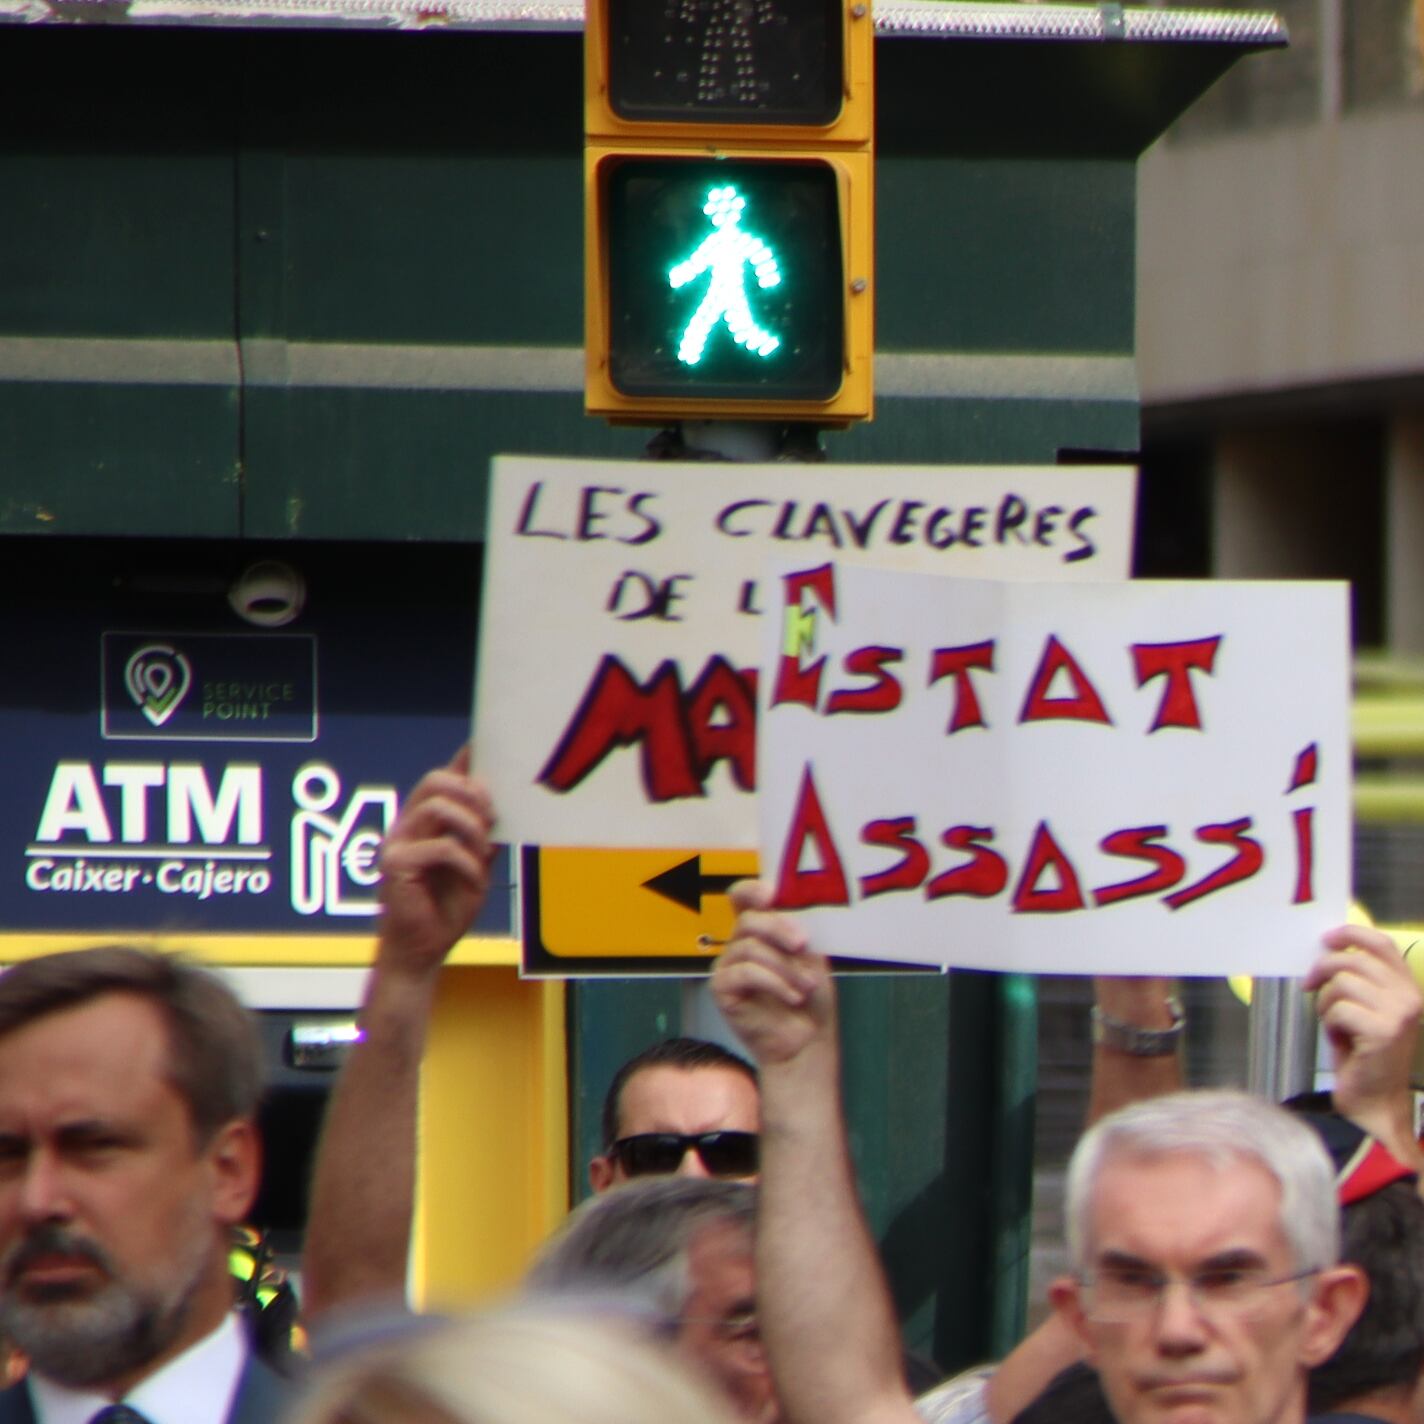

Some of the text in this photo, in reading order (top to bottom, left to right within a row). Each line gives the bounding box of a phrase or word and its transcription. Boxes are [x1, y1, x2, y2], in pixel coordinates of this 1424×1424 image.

[517, 479, 1098, 561] LES CLAVEGERES
[607, 571, 762, 621] DE L
[771, 561, 1224, 734] ESTAT
[203, 703, 272, 720] POINT
[204, 682, 295, 701] SERVICE
[537, 653, 758, 803] MA
[36, 763, 262, 843] ATM
[774, 741, 1319, 912] ASSASSÍ
